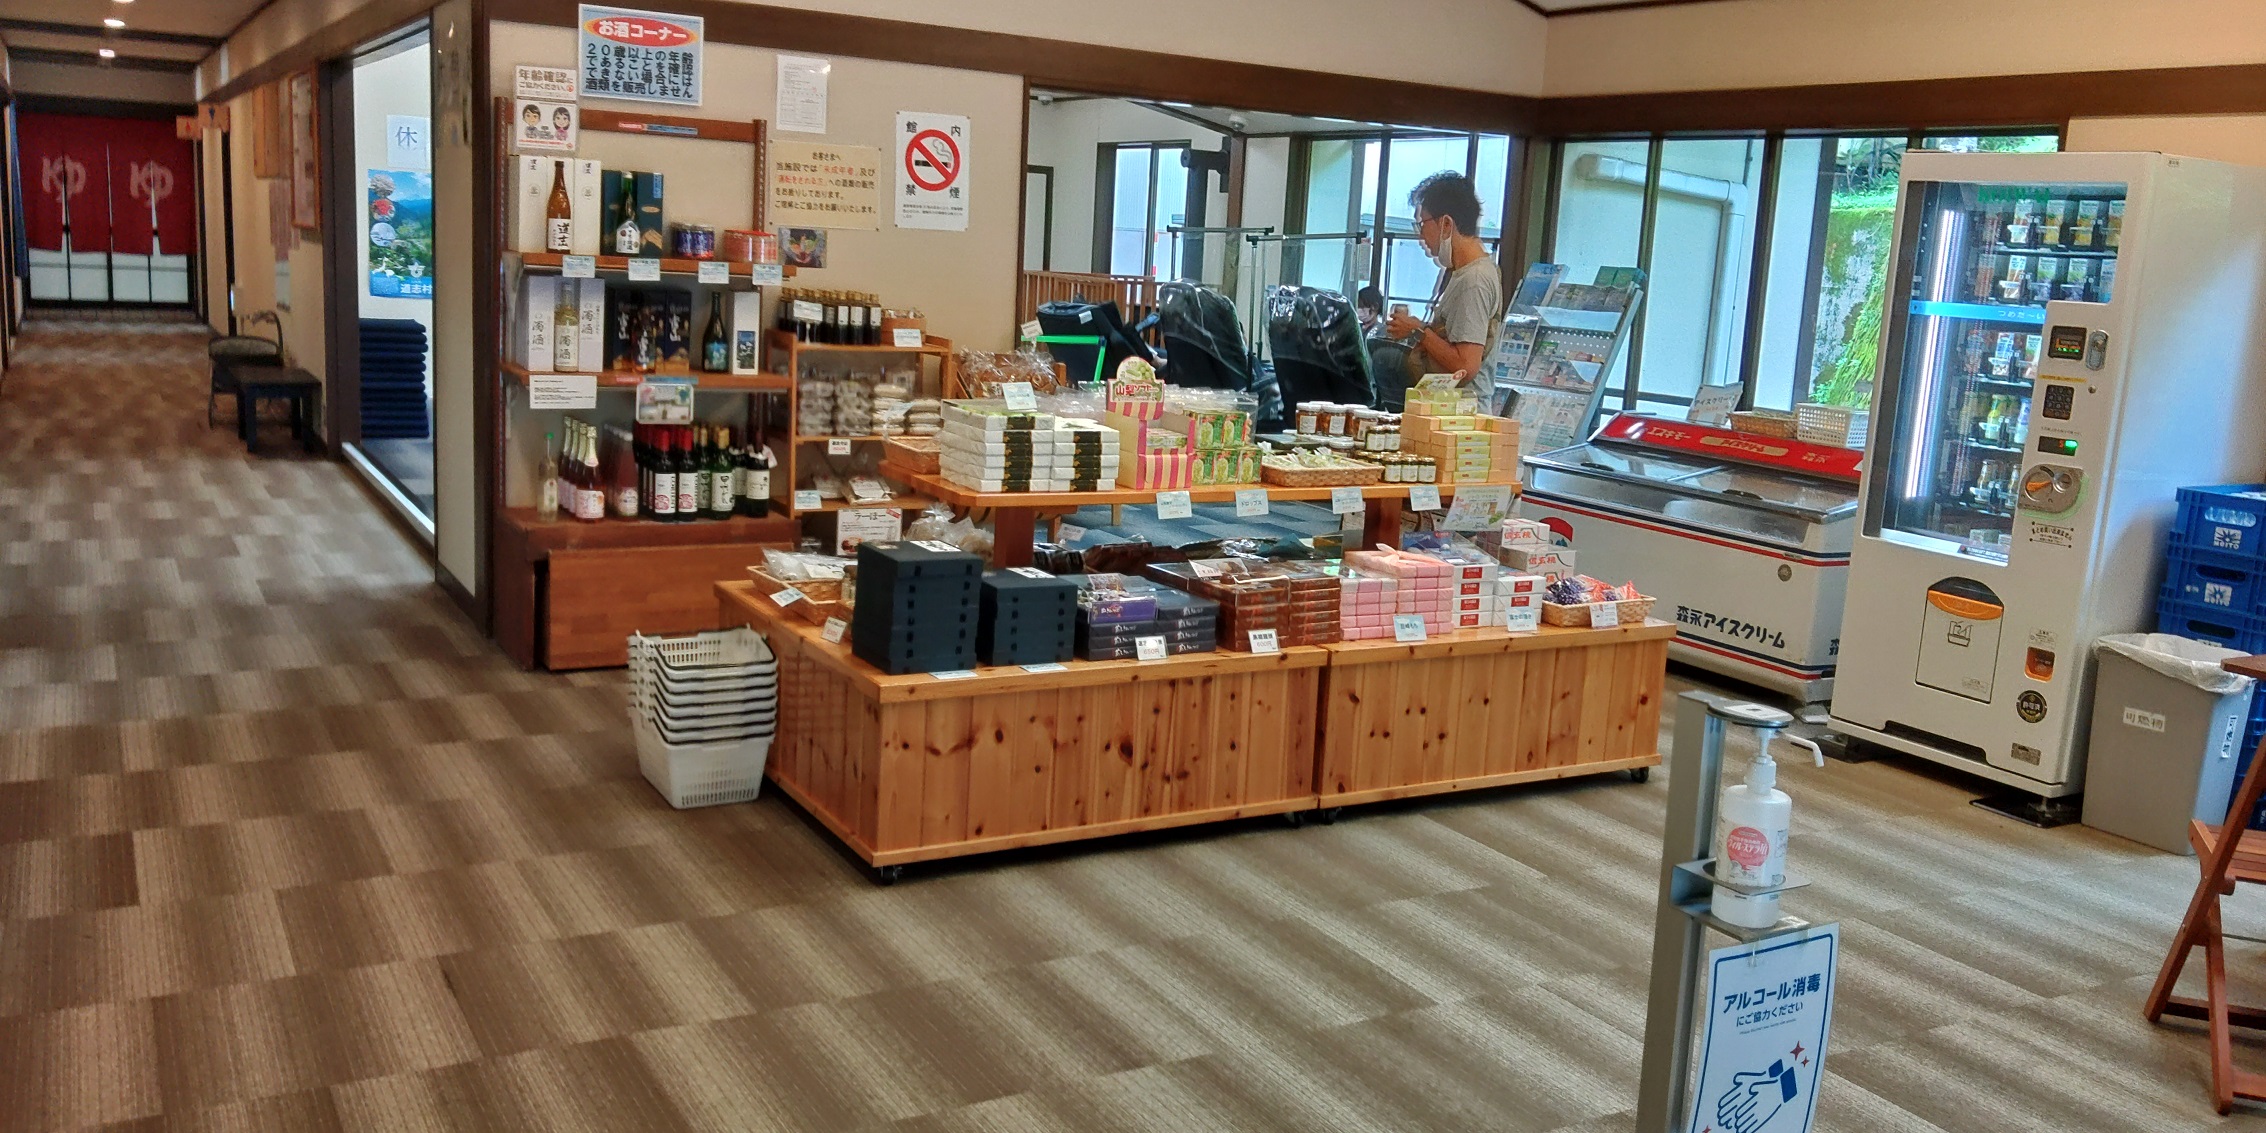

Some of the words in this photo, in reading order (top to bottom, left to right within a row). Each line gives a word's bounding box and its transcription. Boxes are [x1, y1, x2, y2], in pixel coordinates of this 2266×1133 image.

[598, 20, 687, 40] お酒コーナー
[395, 126, 418, 148] 休
[906, 121, 918, 133] 館
[950, 125, 961, 137] 内
[42, 154, 87, 203] ゆ
[130, 160, 174, 207] ゆ
[906, 184, 916, 196] 禁
[949, 187, 960, 198] 煙
[1677, 605, 1786, 649] 森永アイスクリーム
[1723, 973, 1822, 1014] アルコール消毒
[1736, 1002, 1804, 1027] にご協力ください
